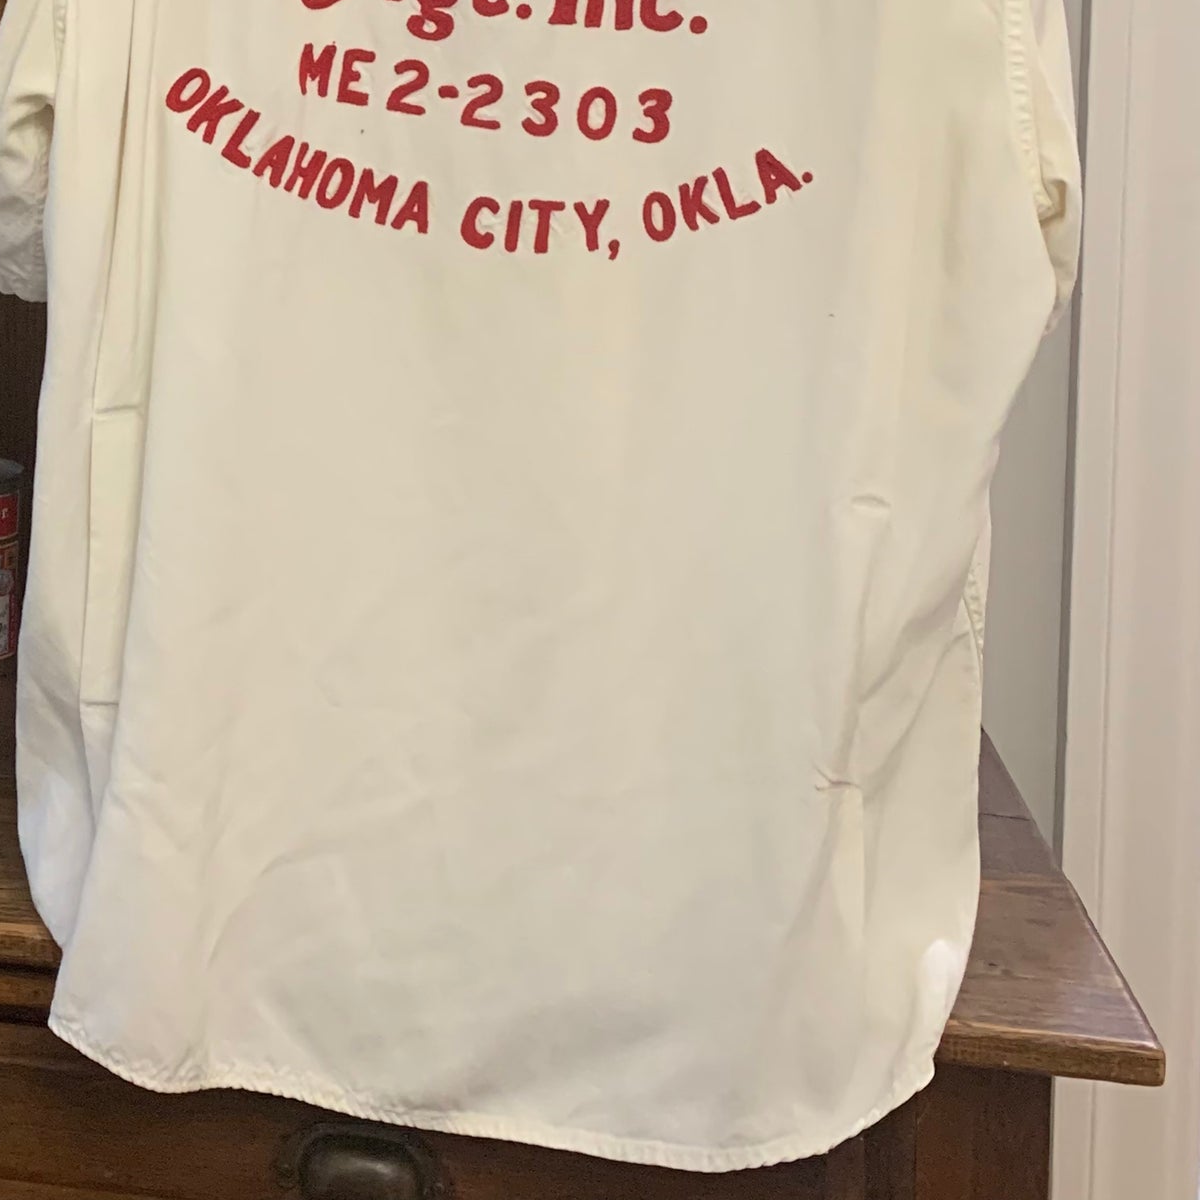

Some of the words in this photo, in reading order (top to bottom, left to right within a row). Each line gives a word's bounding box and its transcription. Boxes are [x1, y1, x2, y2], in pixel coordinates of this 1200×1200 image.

[165, 67, 429, 234] OKLAHOMA
[459, 196, 621, 260] CITY,
[641, 148, 813, 243] OKLA.
[298, 43, 376, 106] ME
[386, 59, 673, 144] 2-2303
